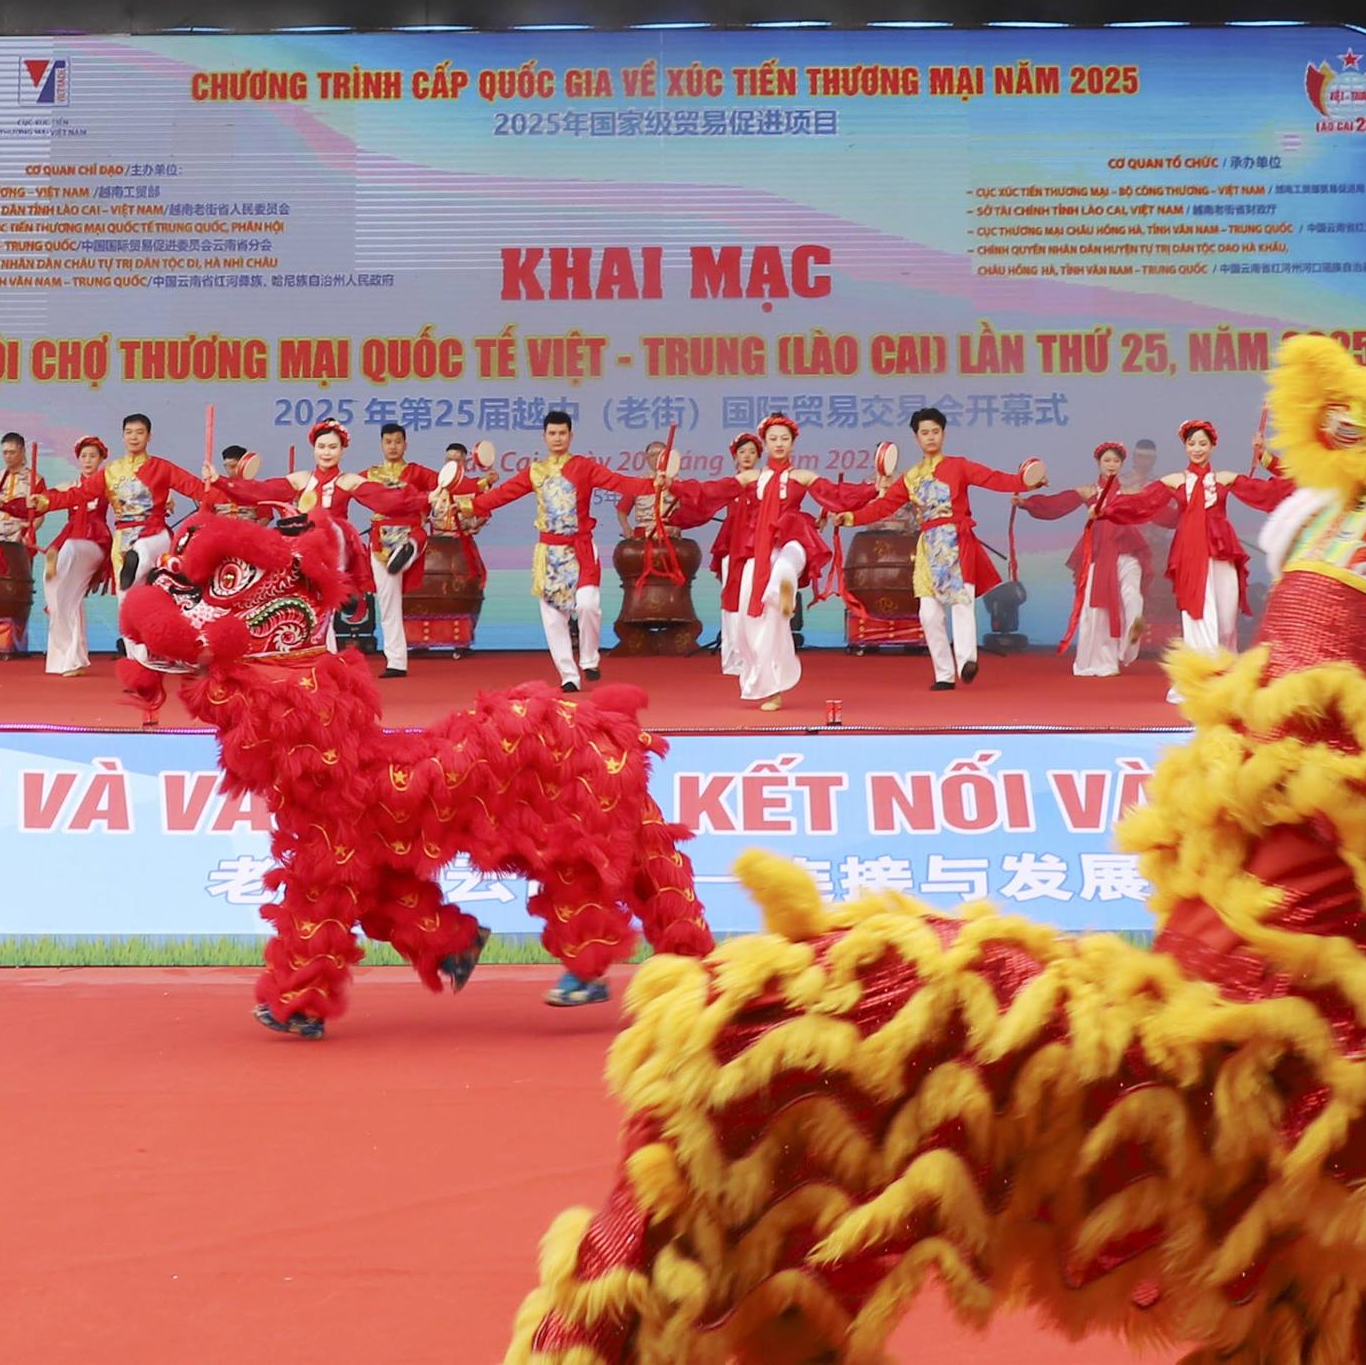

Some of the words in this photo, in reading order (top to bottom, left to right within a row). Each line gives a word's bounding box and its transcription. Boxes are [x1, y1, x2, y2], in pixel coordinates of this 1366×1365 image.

[192, 68, 307, 101] CHƯƠNG
[318, 64, 402, 100] TRÌNH
[412, 61, 469, 99] CẤP
[479, 60, 554, 101] QUỐC
[565, 69, 612, 98] GIA
[623, 60, 655, 97] VỀ
[667, 64, 723, 97] XÚC
[733, 58, 796, 97] TIẾN
[807, 63, 919, 96] THƯƠNG
[930, 66, 983, 101] MẠI
[994, 61, 1059, 95] NĂM
[1070, 66, 1138, 94] 2025
[43, 166, 75, 177] QUAN
[1128, 158, 1163, 169] QUAN
[63, 187, 89, 198] NAM
[81, 205, 100, 215] CAI
[137, 204, 163, 215] NAM
[501, 246, 663, 300] KHAI
[690, 244, 831, 313] MẠC
[32, 333, 108, 389] CHỢ
[120, 335, 267, 380] THƯƠNG
[280, 339, 348, 387] MẠI
[363, 326, 464, 383] QUỐC
[475, 325, 515, 378] TẾ
[527, 330, 606, 386] VIỆT
[643, 337, 765, 377] TRUNG
[780, 329, 858, 376] (LÀO
[959, 321, 1024, 374] LẦN
[1036, 326, 1112, 374] THỨ
[1122, 334, 1177, 377] 25,
[1189, 326, 1269, 371] NĂM
[274, 398, 354, 427] 2025
[21, 760, 131, 831] VÀ
[677, 755, 843, 832] KẾT
[871, 753, 1030, 831] NỐI
